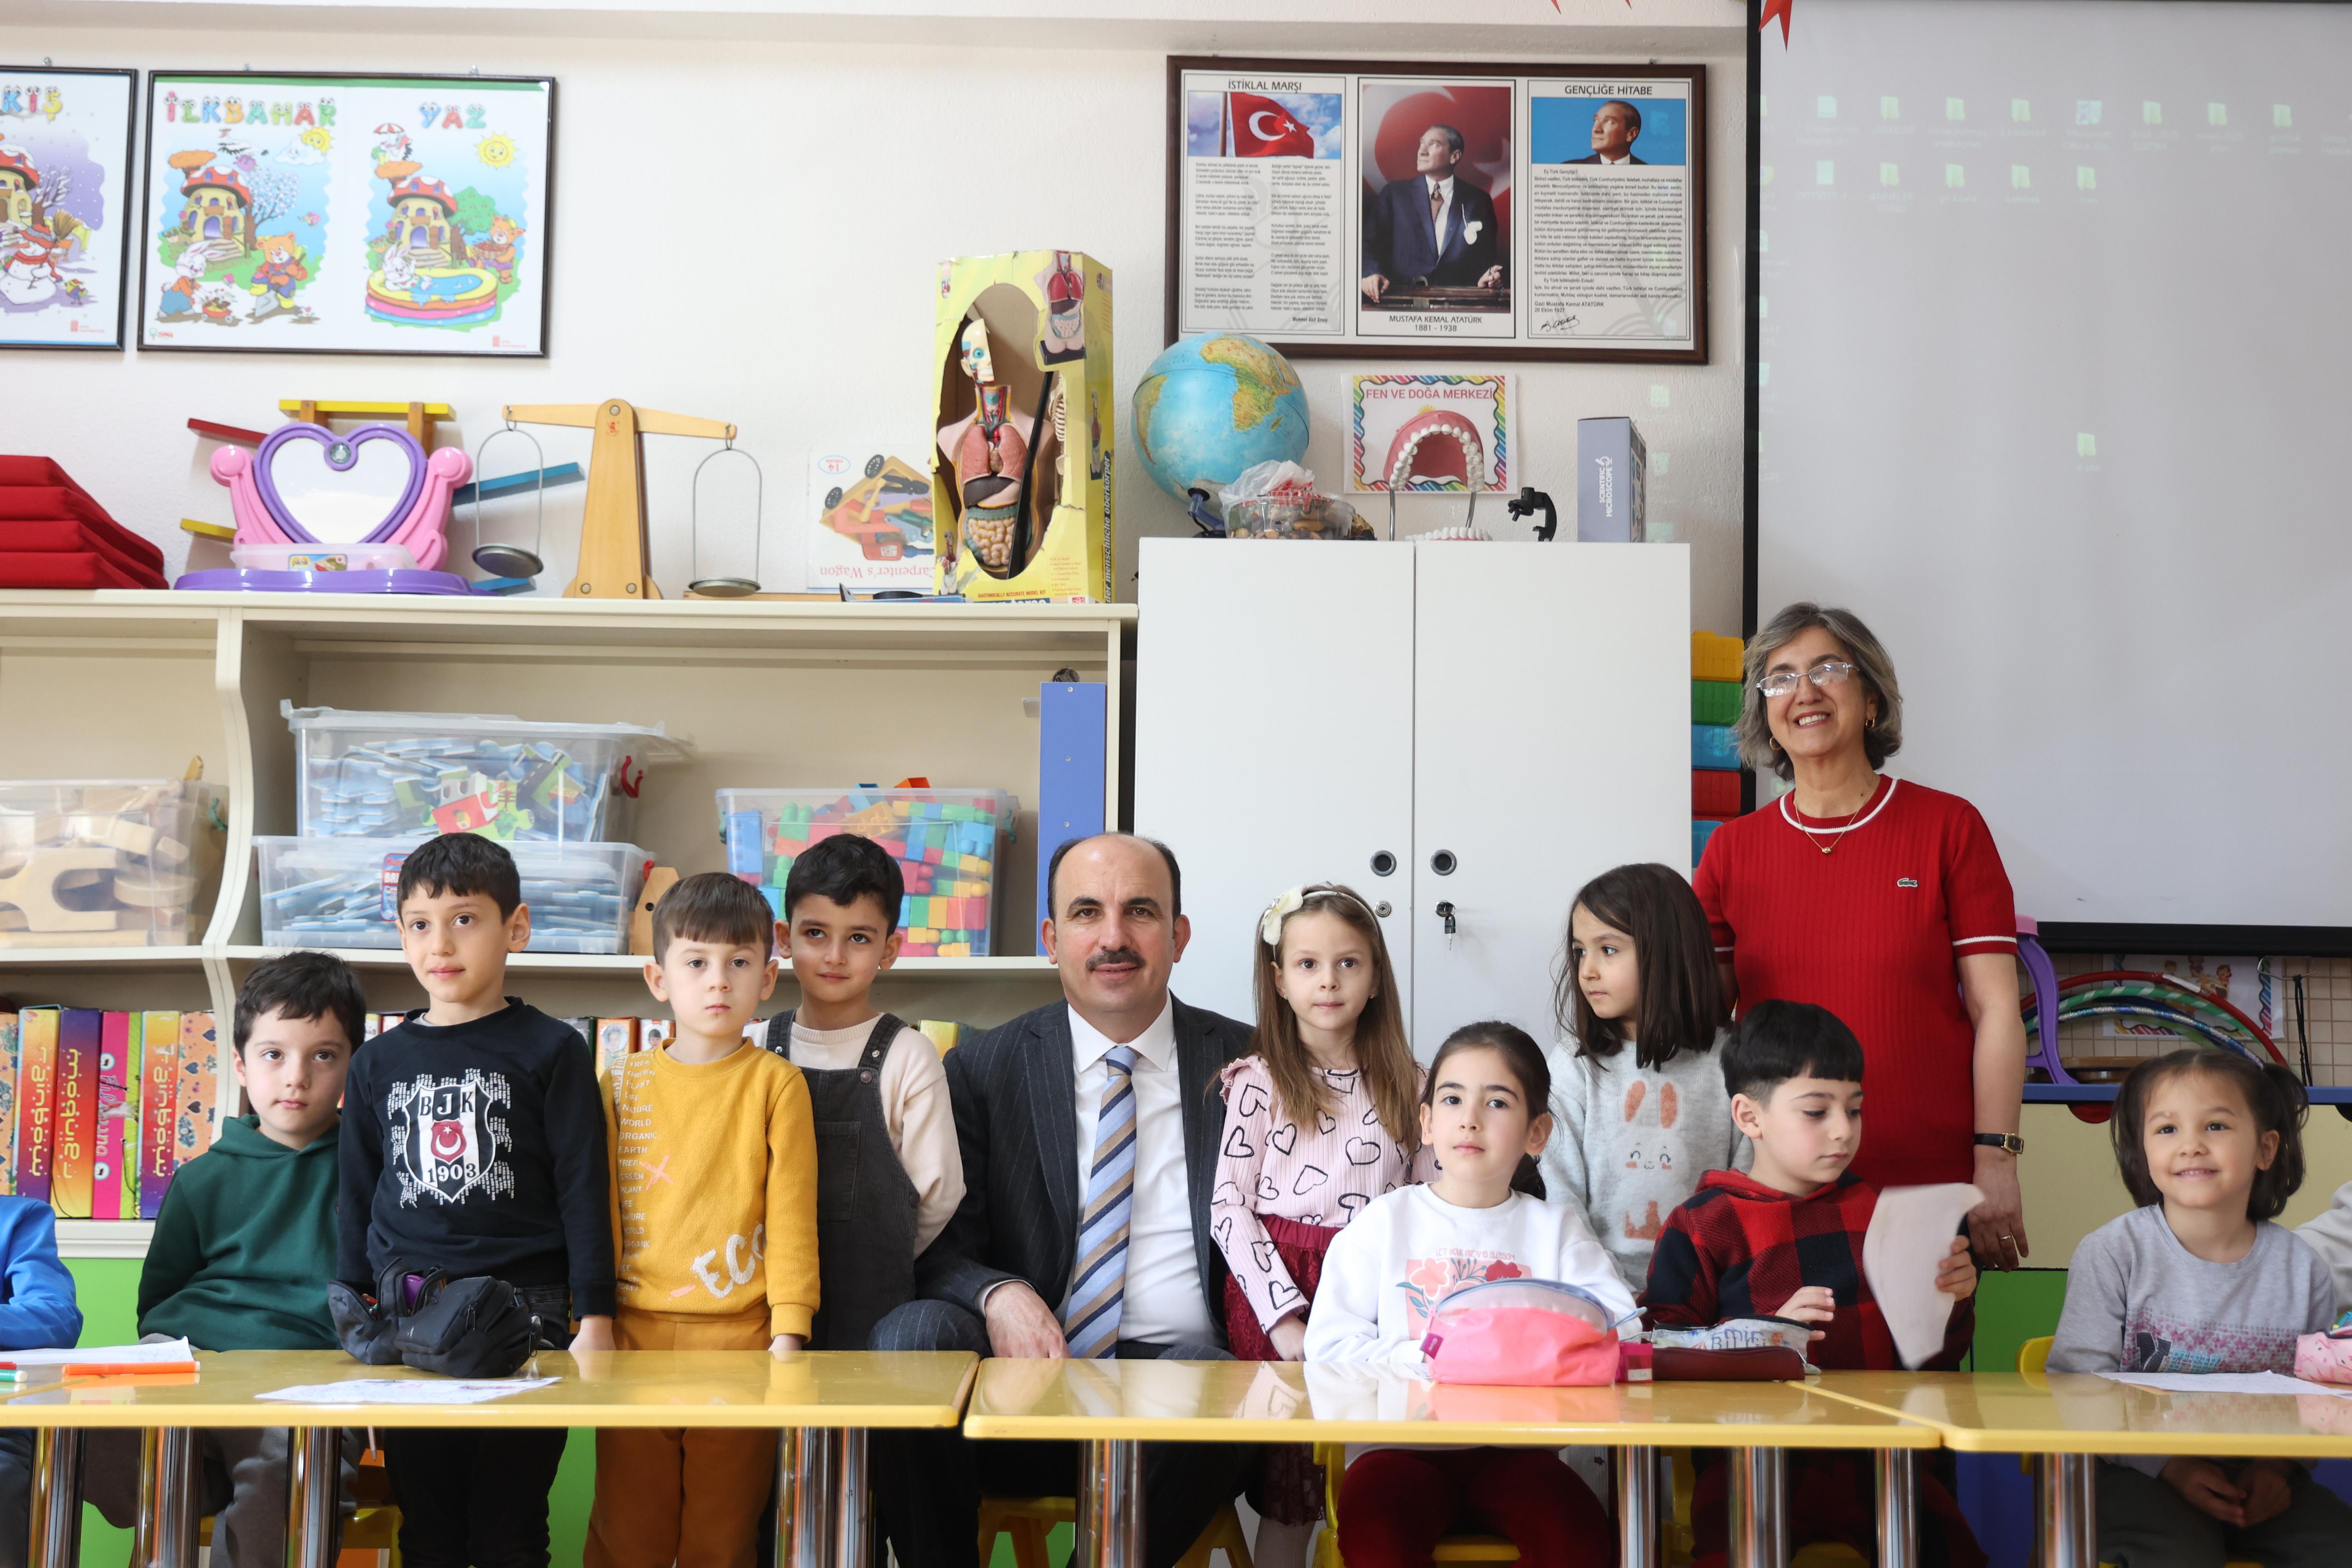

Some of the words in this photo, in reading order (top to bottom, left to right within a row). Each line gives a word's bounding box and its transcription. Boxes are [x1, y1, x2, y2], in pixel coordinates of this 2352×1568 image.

[1228, 79, 1268, 90] İSTİKLAL
[1272, 81, 1302, 93] MARŞI
[1565, 84, 1614, 97] GENÇLİĞE
[1617, 84, 1652, 96] HİTABE
[2, 85, 62, 120] KIŞ
[164, 91, 336, 126] İLKBAHAR
[419, 101, 486, 129] YAZ
[1451, 315, 1482, 323] ATATÜRK
[1366, 390, 1388, 399] FEN
[1391, 390, 1405, 399] VE
[1408, 387, 1440, 399] DOĞA
[1443, 387, 1493, 399] MERKEZİ
[820, 565, 862, 578] Wagon
[420, 1092, 474, 1115] BJK
[622, 1104, 654, 1113] NATURE
[621, 1118, 651, 1126] WORLD
[429, 1163, 478, 1183] 1903
[1436, 1248, 1447, 1257] LET
[1464, 1249, 1488, 1258] DREAMS
[1490, 1251, 1515, 1261] BLOSSOM
